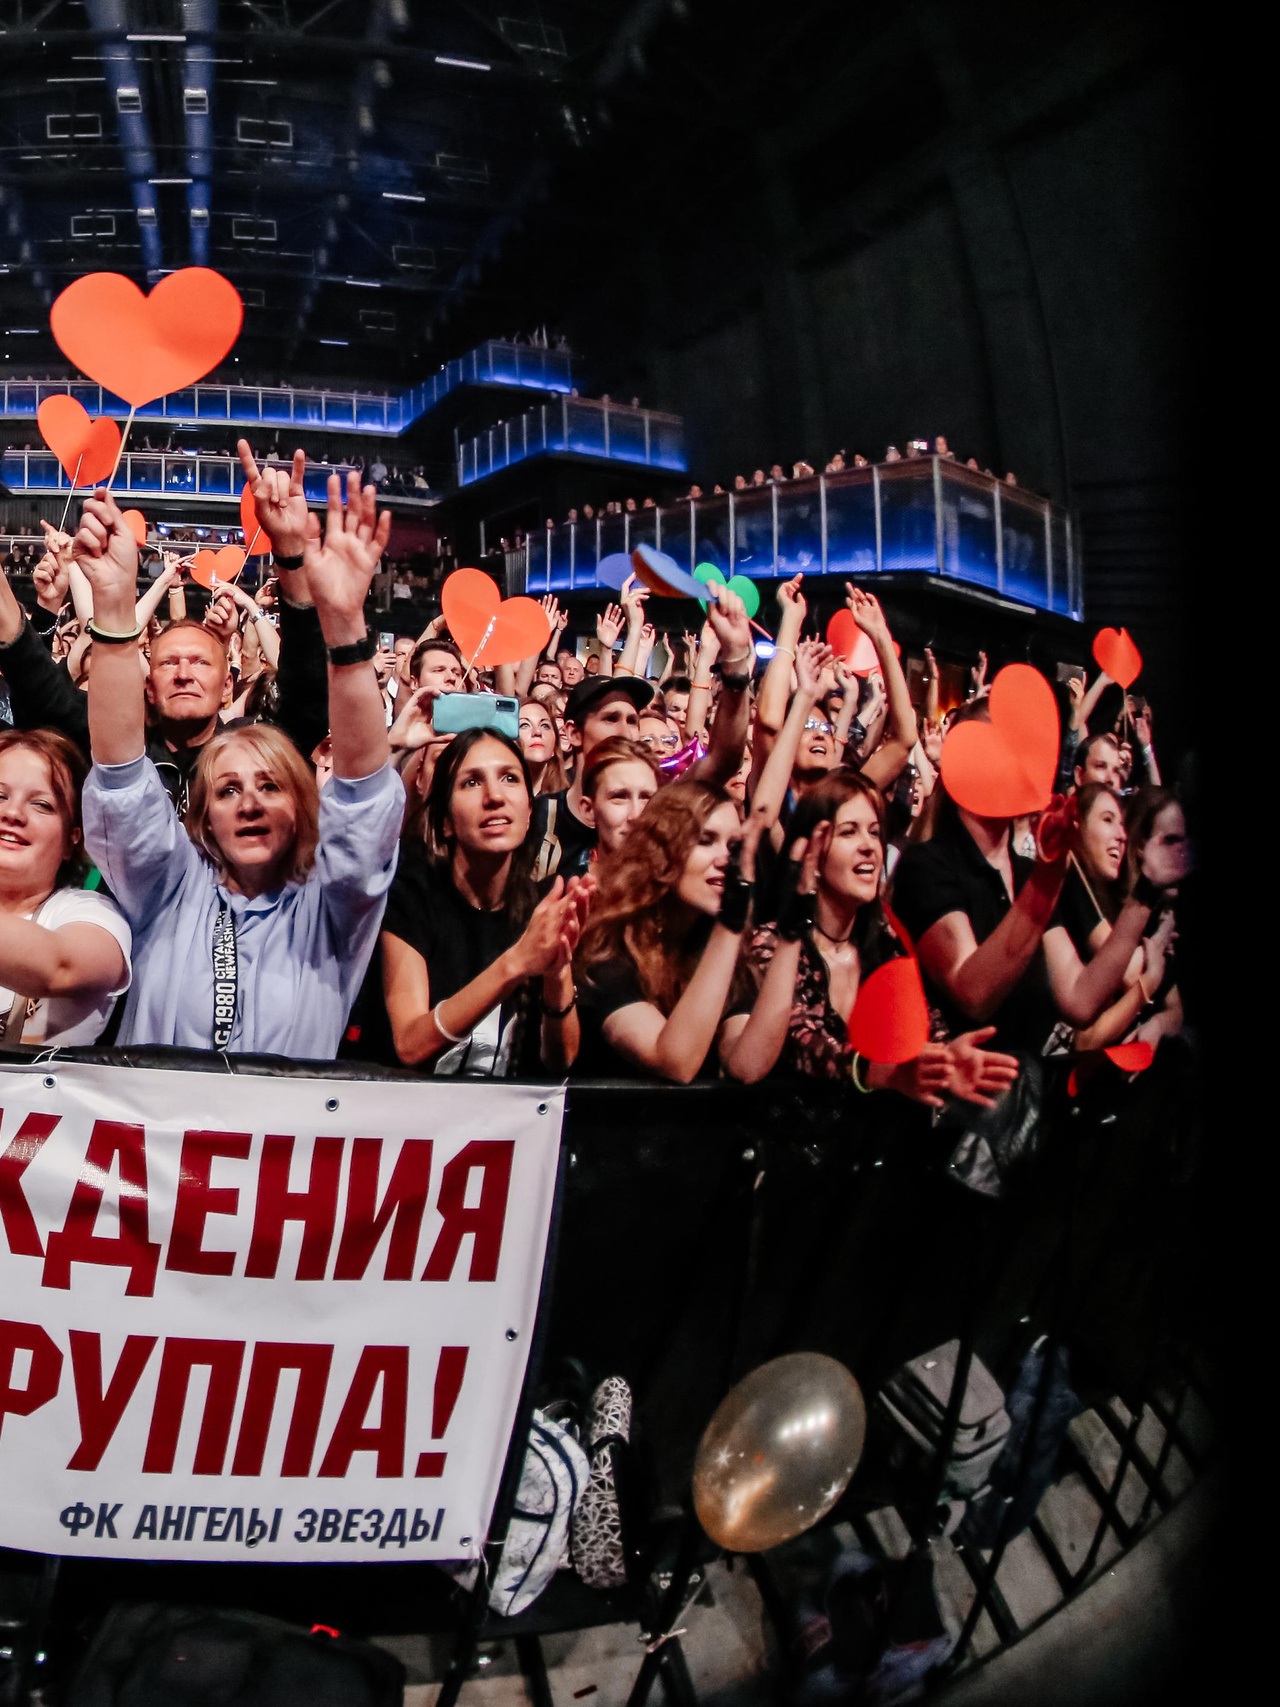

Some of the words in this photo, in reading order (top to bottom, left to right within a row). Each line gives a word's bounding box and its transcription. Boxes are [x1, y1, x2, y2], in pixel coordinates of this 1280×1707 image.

[59, 1502, 124, 1539] ФК
[132, 1504, 284, 1543] АНГЕЛЫ
[293, 1507, 447, 1549] ЗВЕЗДЫ
